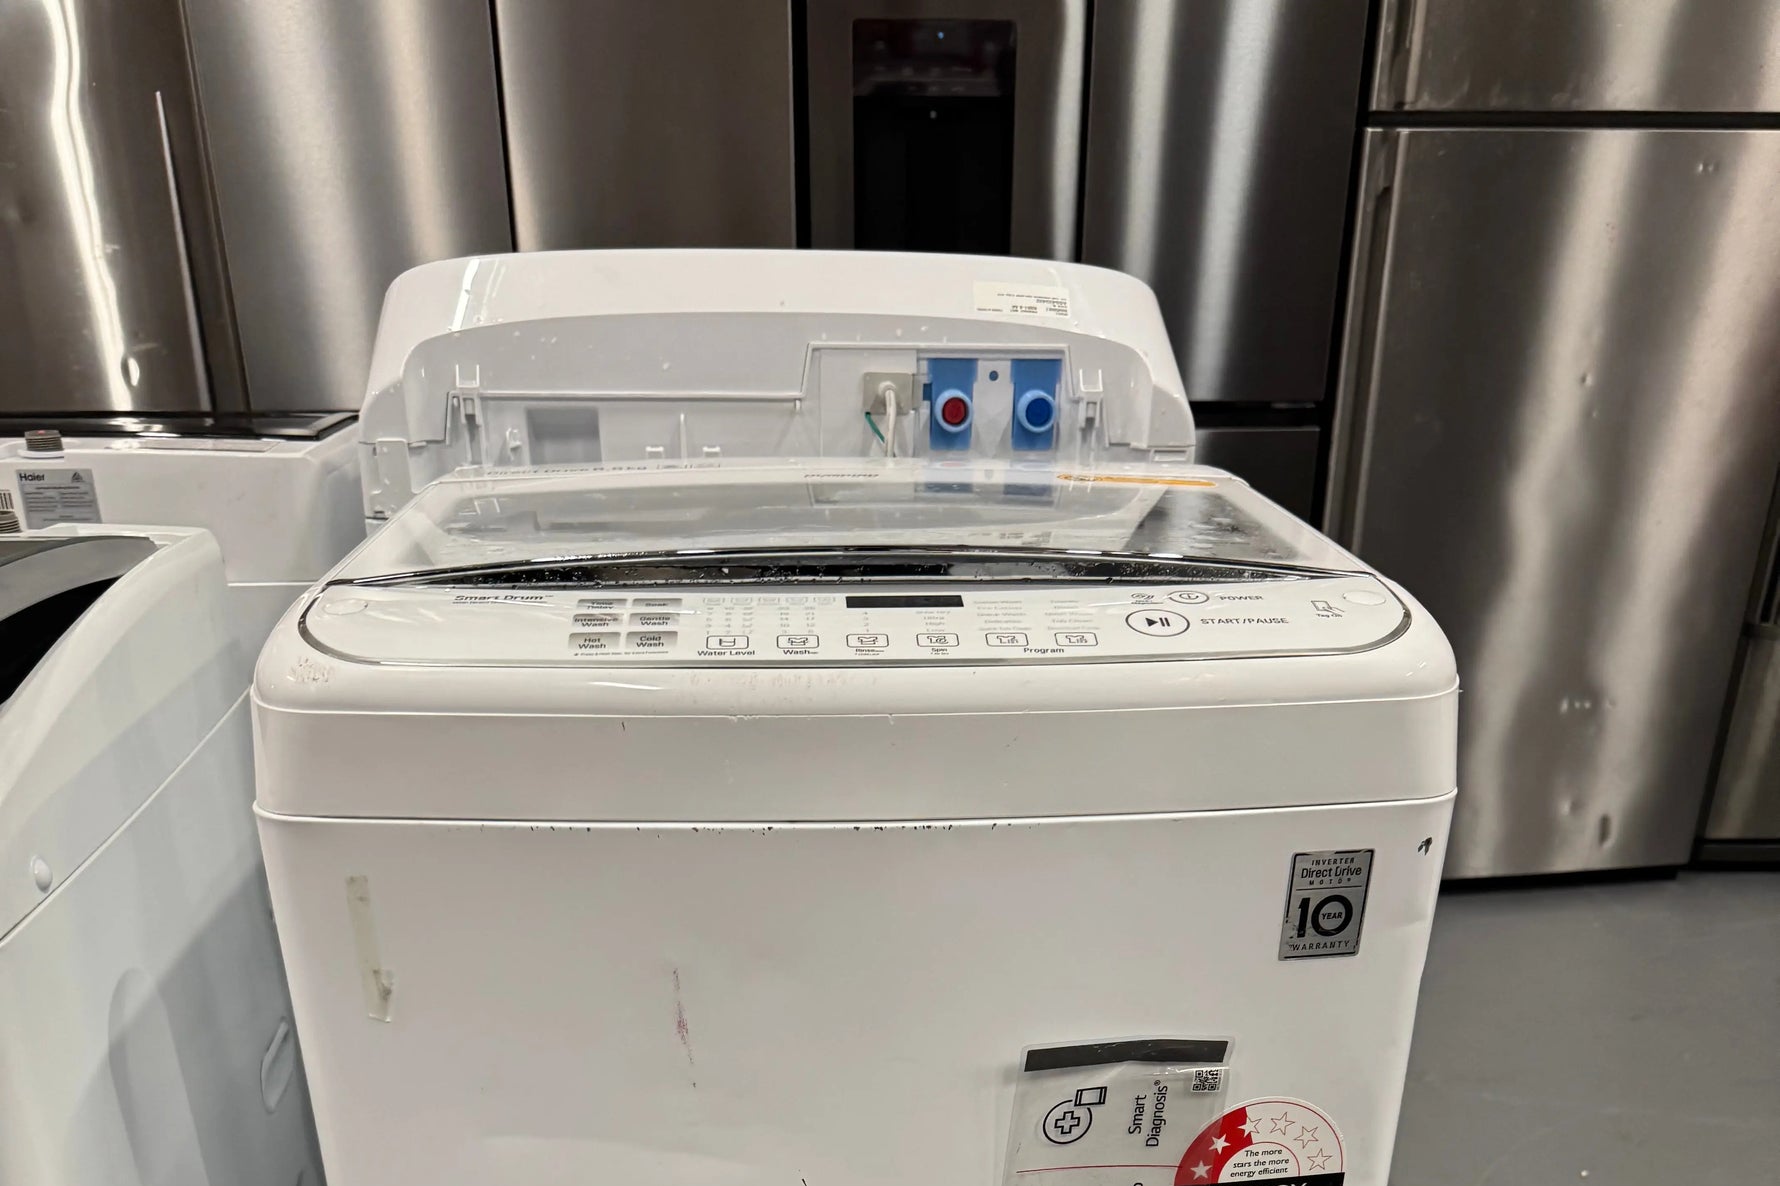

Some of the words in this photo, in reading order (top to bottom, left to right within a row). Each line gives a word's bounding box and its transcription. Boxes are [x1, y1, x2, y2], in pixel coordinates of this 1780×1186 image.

[19, 473, 45, 481] Haier
[1312, 857, 1355, 866] INVERTER
[1301, 868, 1332, 879] Direct
[1334, 866, 1362, 877] Drive
[1297, 894, 1353, 938] 10
[1321, 912, 1343, 920] YEAR
[1290, 940, 1350, 951] WARRANTY
[1128, 1094, 1147, 1135] Smart
[1233, 1161, 1252, 1169] stars
[1258, 1167, 1288, 1176] efficient
